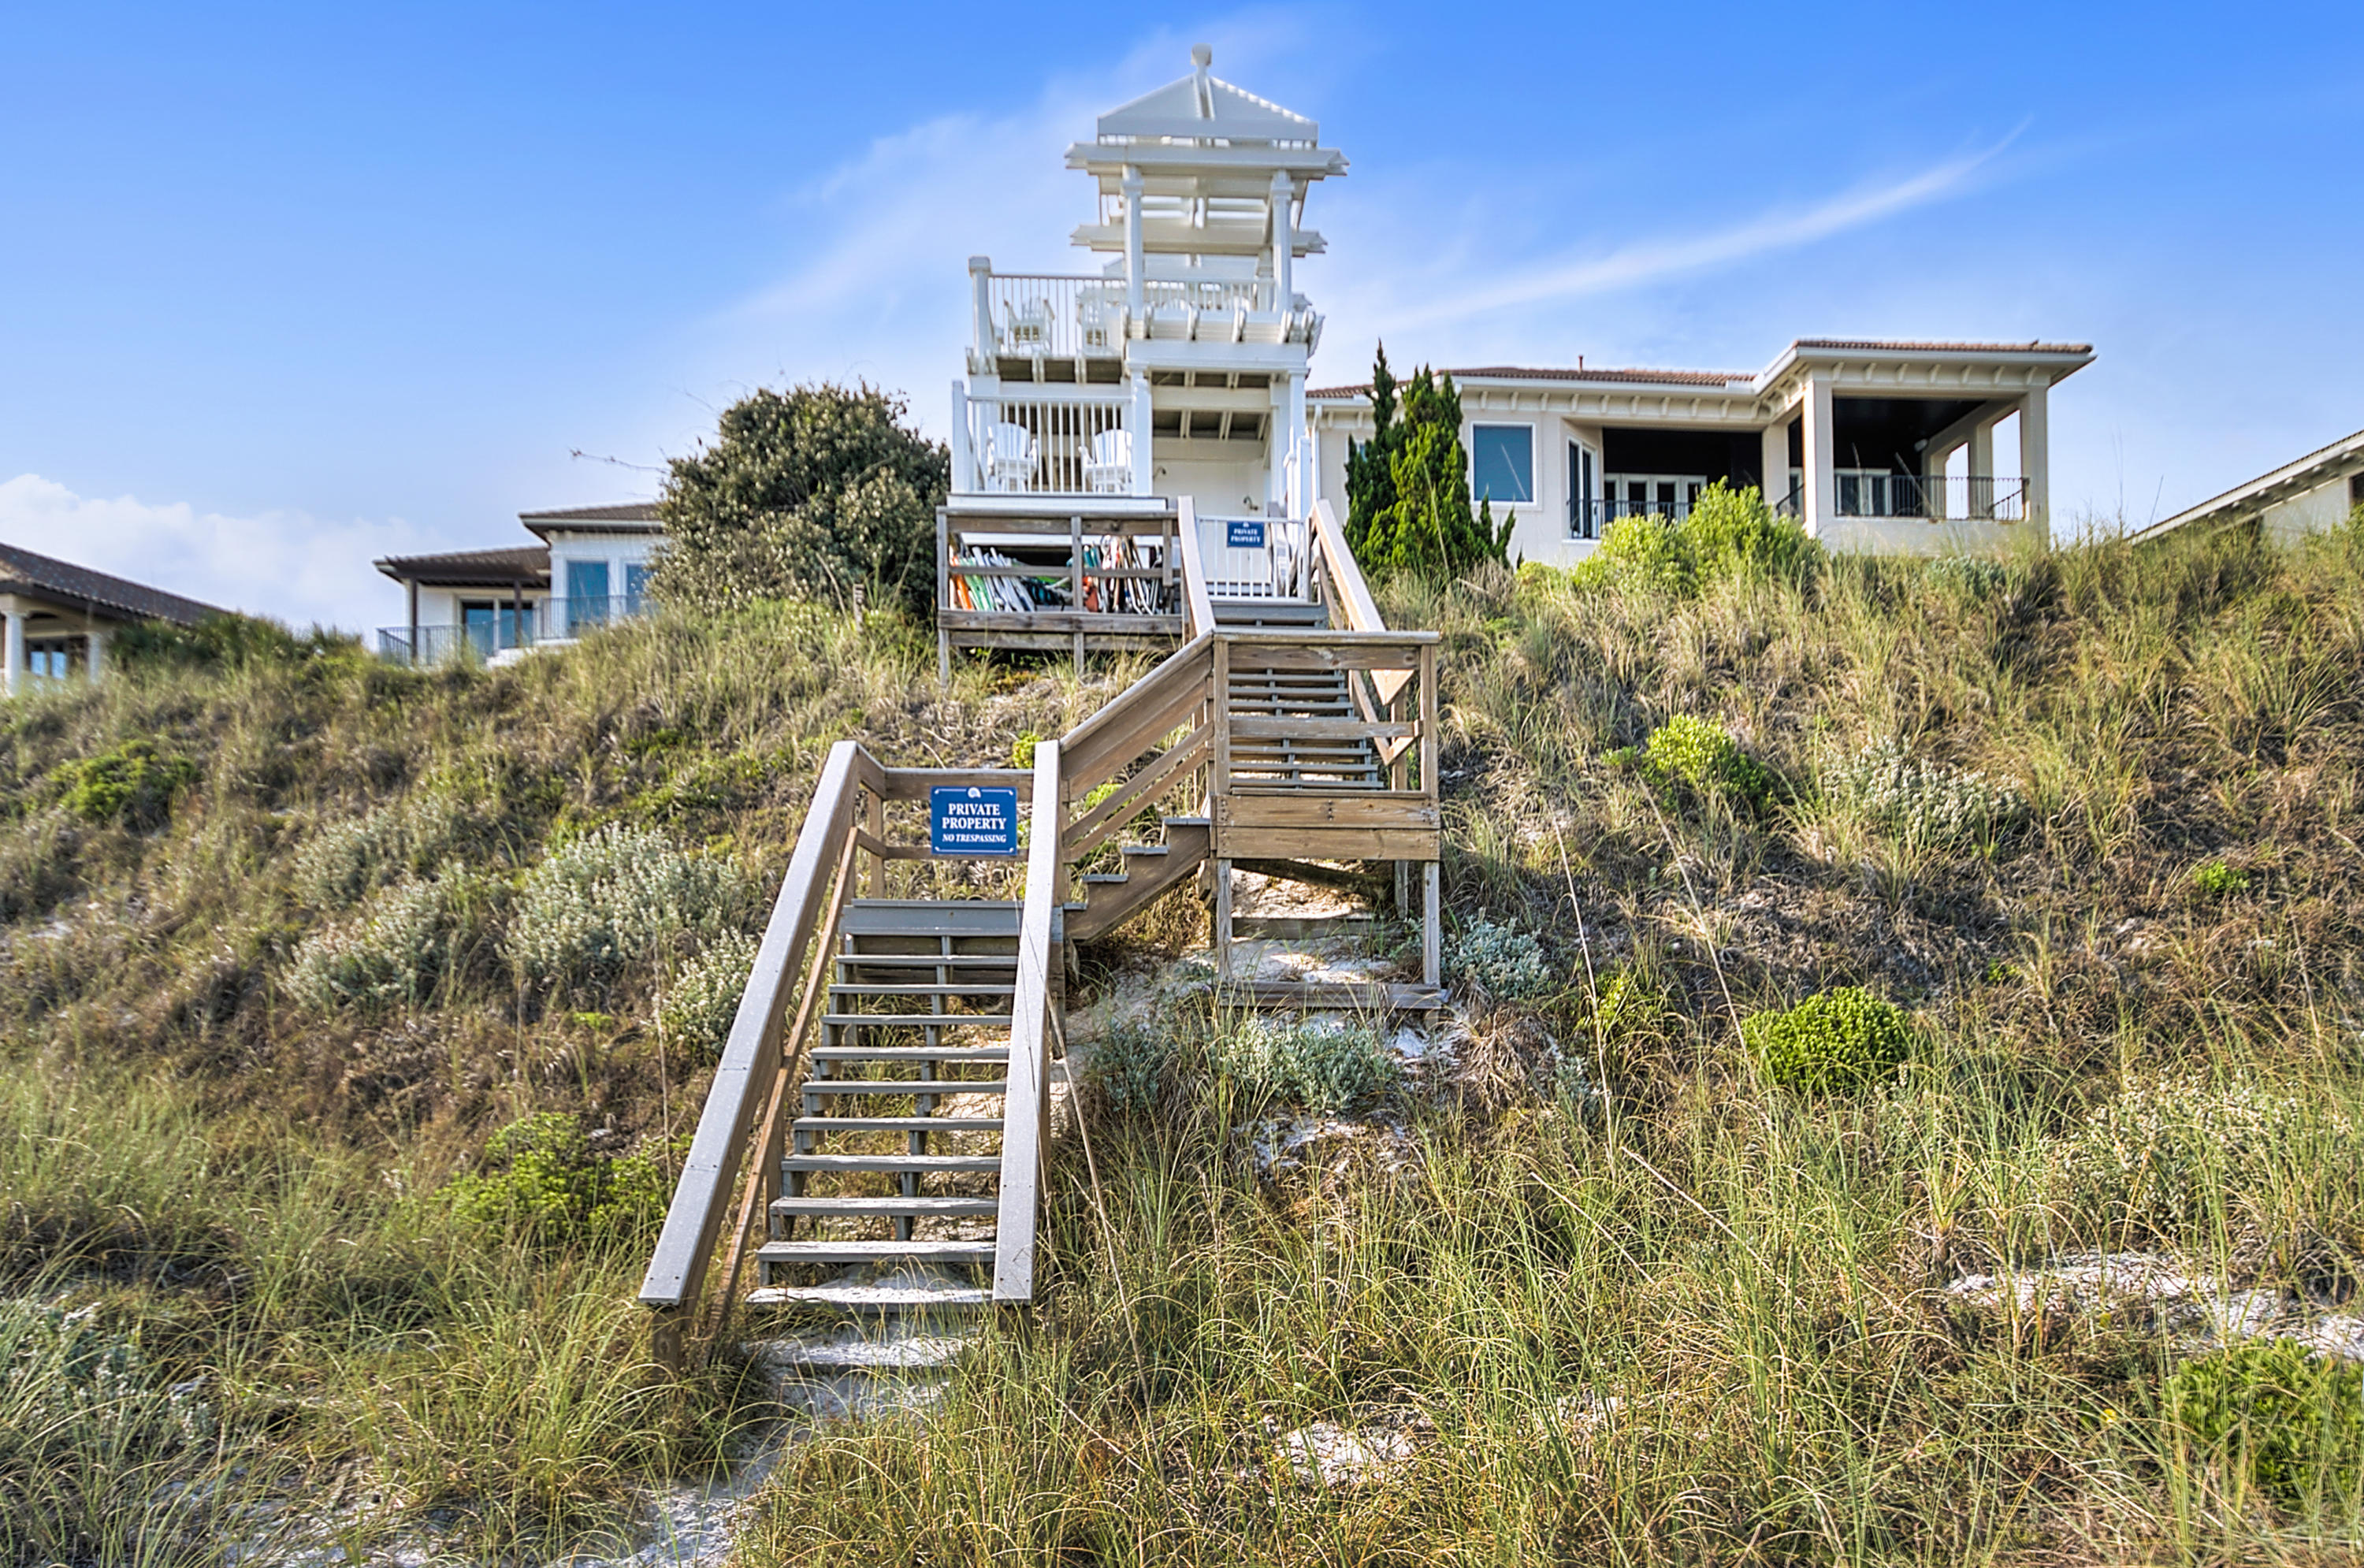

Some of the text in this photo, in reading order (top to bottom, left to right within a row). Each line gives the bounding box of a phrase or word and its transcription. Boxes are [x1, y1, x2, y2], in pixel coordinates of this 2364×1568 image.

[948, 803, 1001, 816] PRIVATE
[942, 817, 1007, 830] PROPERTY
[942, 834, 1007, 843] NO TRESPASSING
